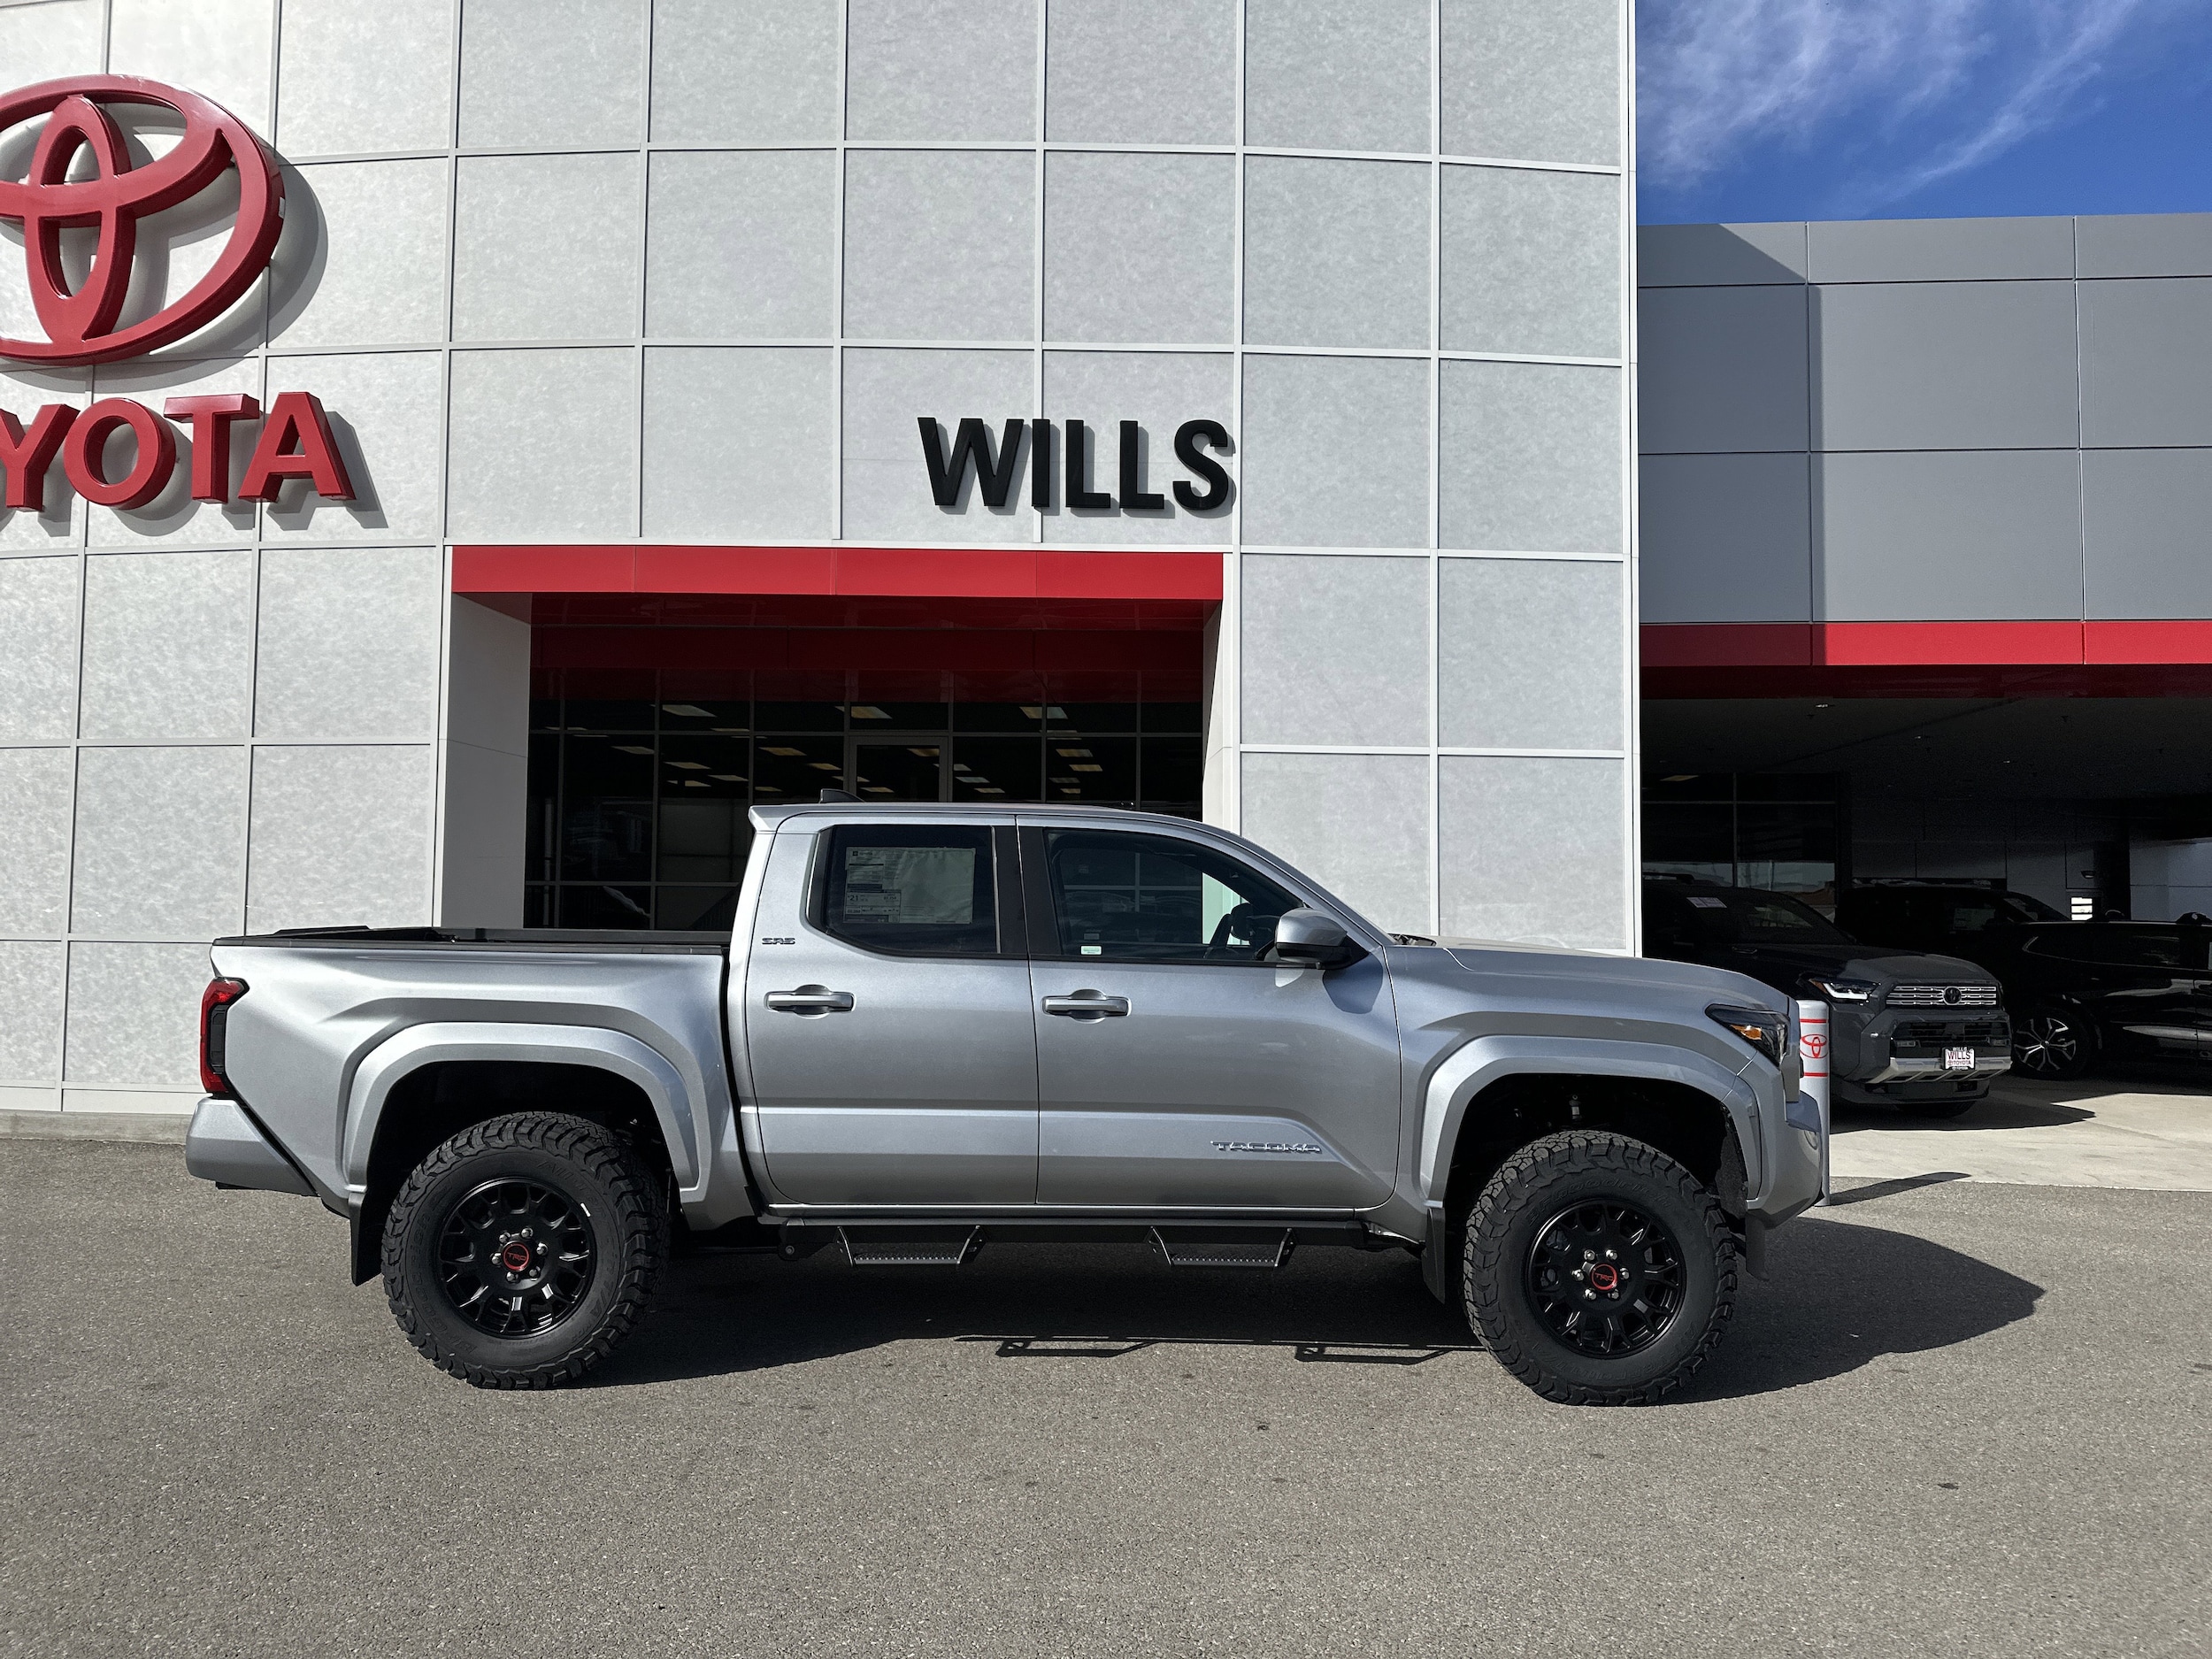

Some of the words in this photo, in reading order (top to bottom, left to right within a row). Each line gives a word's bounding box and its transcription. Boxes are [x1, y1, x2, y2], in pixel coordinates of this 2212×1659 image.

[918, 417, 1229, 511] WILLS
[1947, 1050, 1970, 1060] WILLS
[1210, 1140, 1322, 1154] TACOMA
[507, 1252, 527, 1262] TRD
[1594, 1272, 1614, 1281] TRD
